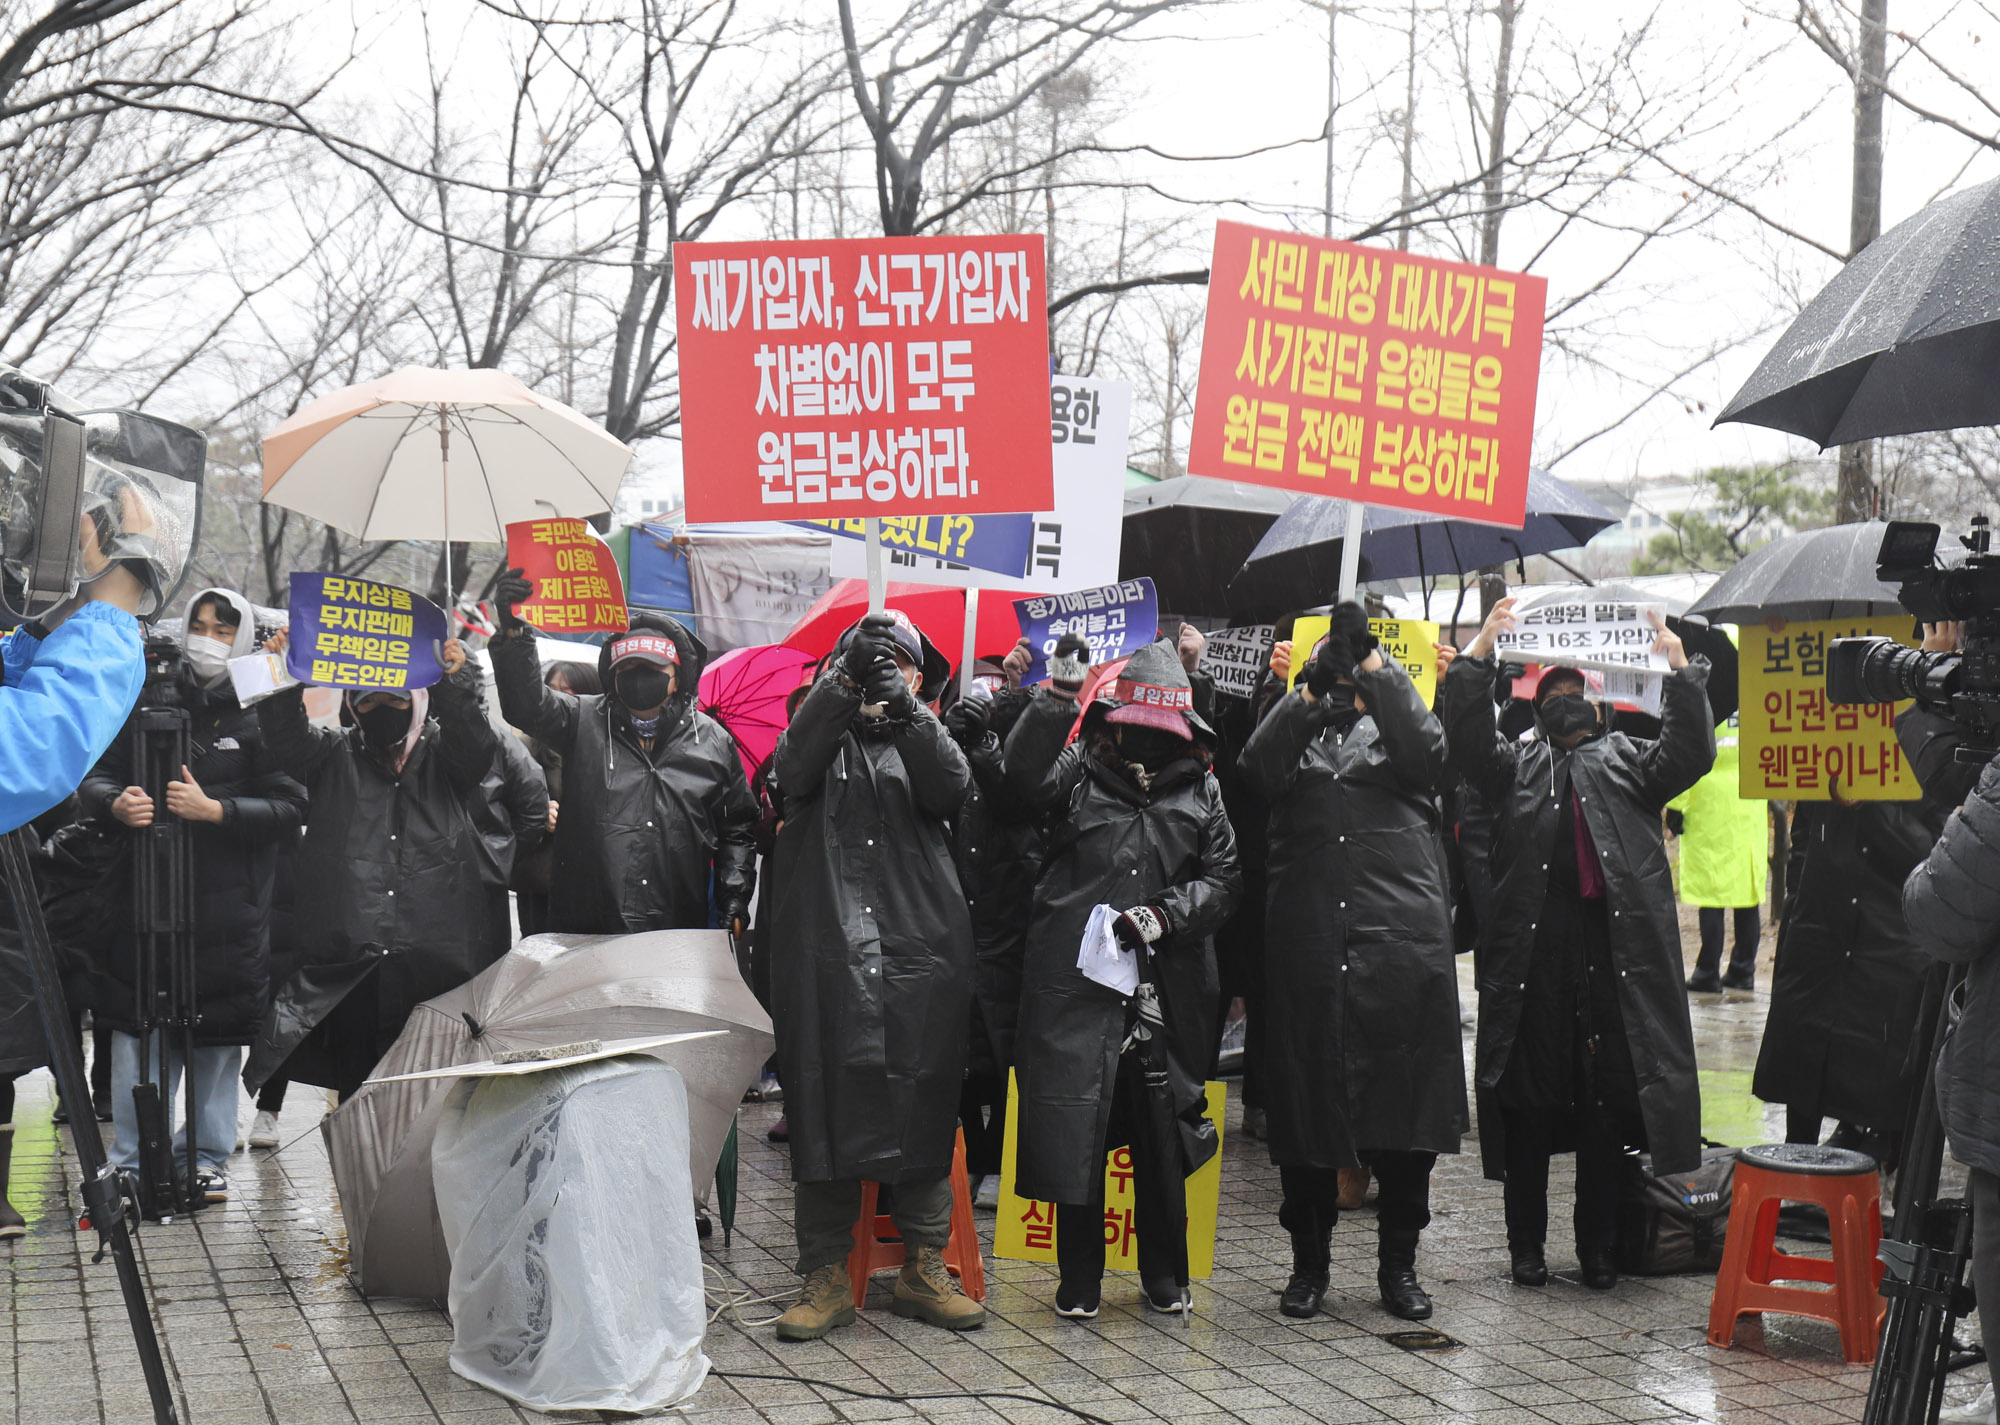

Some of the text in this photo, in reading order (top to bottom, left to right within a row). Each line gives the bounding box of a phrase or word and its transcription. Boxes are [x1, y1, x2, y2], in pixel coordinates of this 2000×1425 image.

[690, 250, 1031, 332] 재가입자, 신규가입자
[1239, 237, 1516, 348] 서민 대상 대사기극
[753, 340, 976, 417] 차별없이 모두
[1235, 317, 1503, 425] 사기집단 은행들은
[757, 427, 980, 504] 원금보상하라.
[1223, 394, 1499, 506] 원금 전액 보상하라
[556, 548, 599, 572] 이용한
[322, 577, 413, 611] 무지상품
[1023, 580, 1145, 620] 정기예금이라
[319, 604, 414, 638] 무지판매
[521, 603, 629, 628] 대국민 사기극
[1048, 608, 1126, 637] 속여놓고
[316, 632, 410, 665] 무책임은
[1207, 641, 1266, 666] 괜찮다
[1497, 632, 1539, 650] 믿은
[1547, 630, 1592, 648] 16조
[311, 659, 408, 688] 말도안돼
[1758, 741, 1901, 789] 웬말이냐!
[1697, 1191, 1719, 1204] YTN
